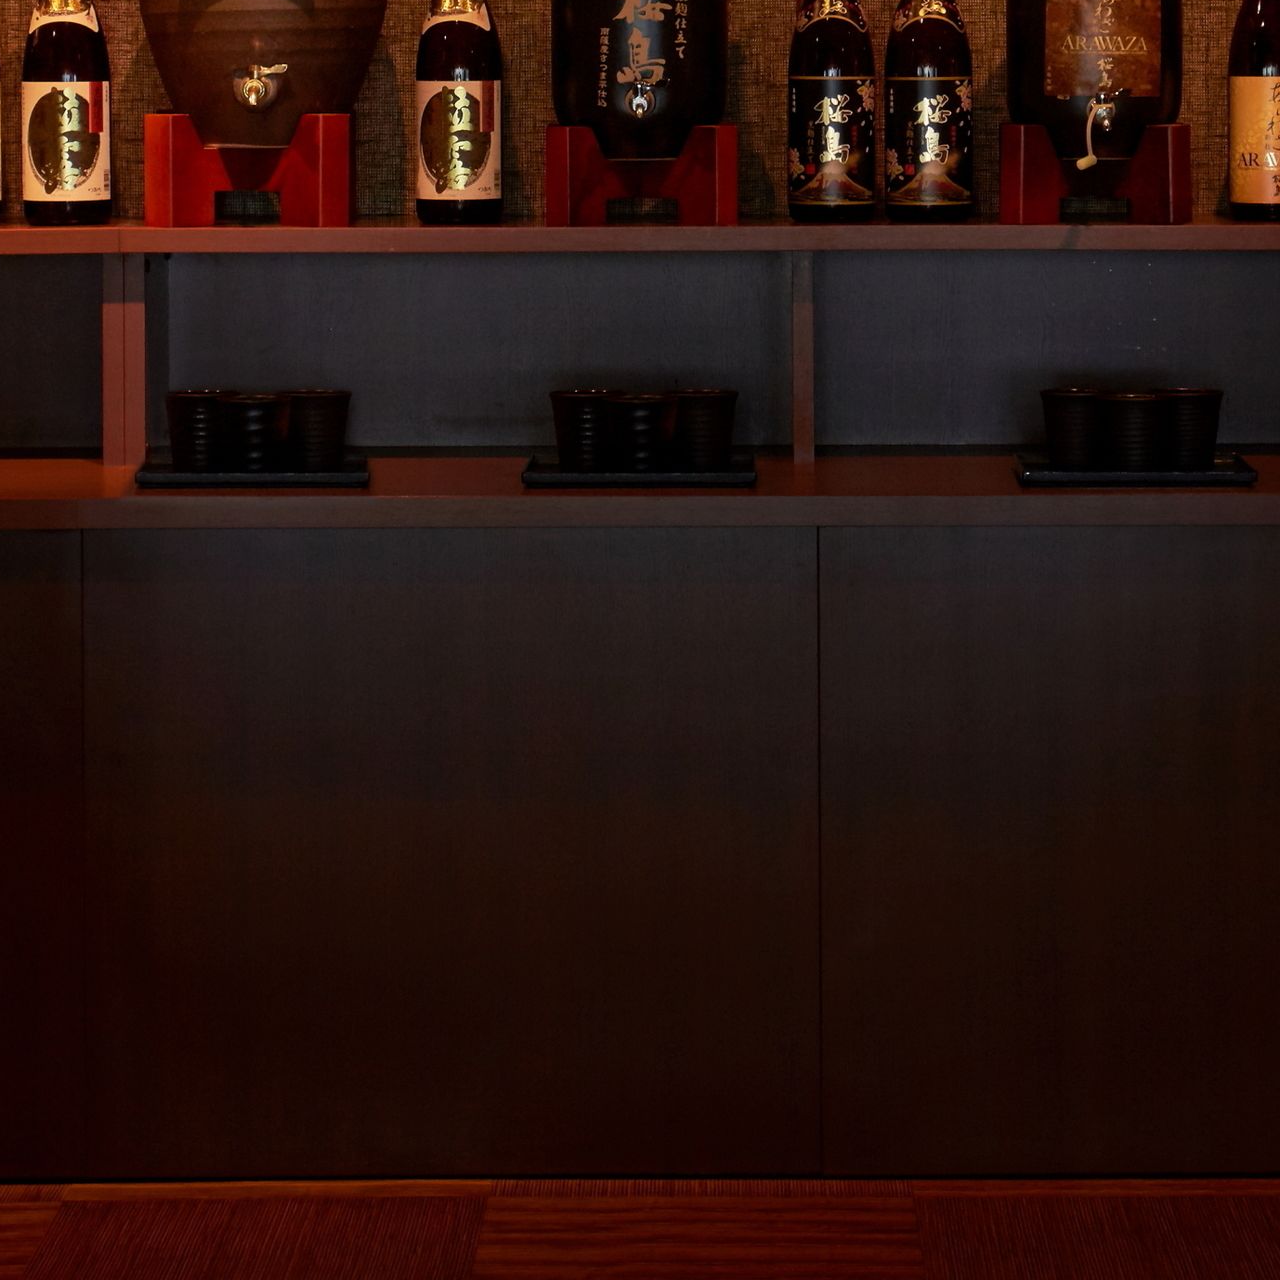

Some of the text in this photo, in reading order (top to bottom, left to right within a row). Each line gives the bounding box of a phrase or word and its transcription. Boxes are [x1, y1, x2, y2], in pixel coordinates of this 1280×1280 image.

[1061, 35, 1148, 51] ARAWAZA
[813, 94, 853, 165] 桜島
[913, 94, 952, 165] 桜島
